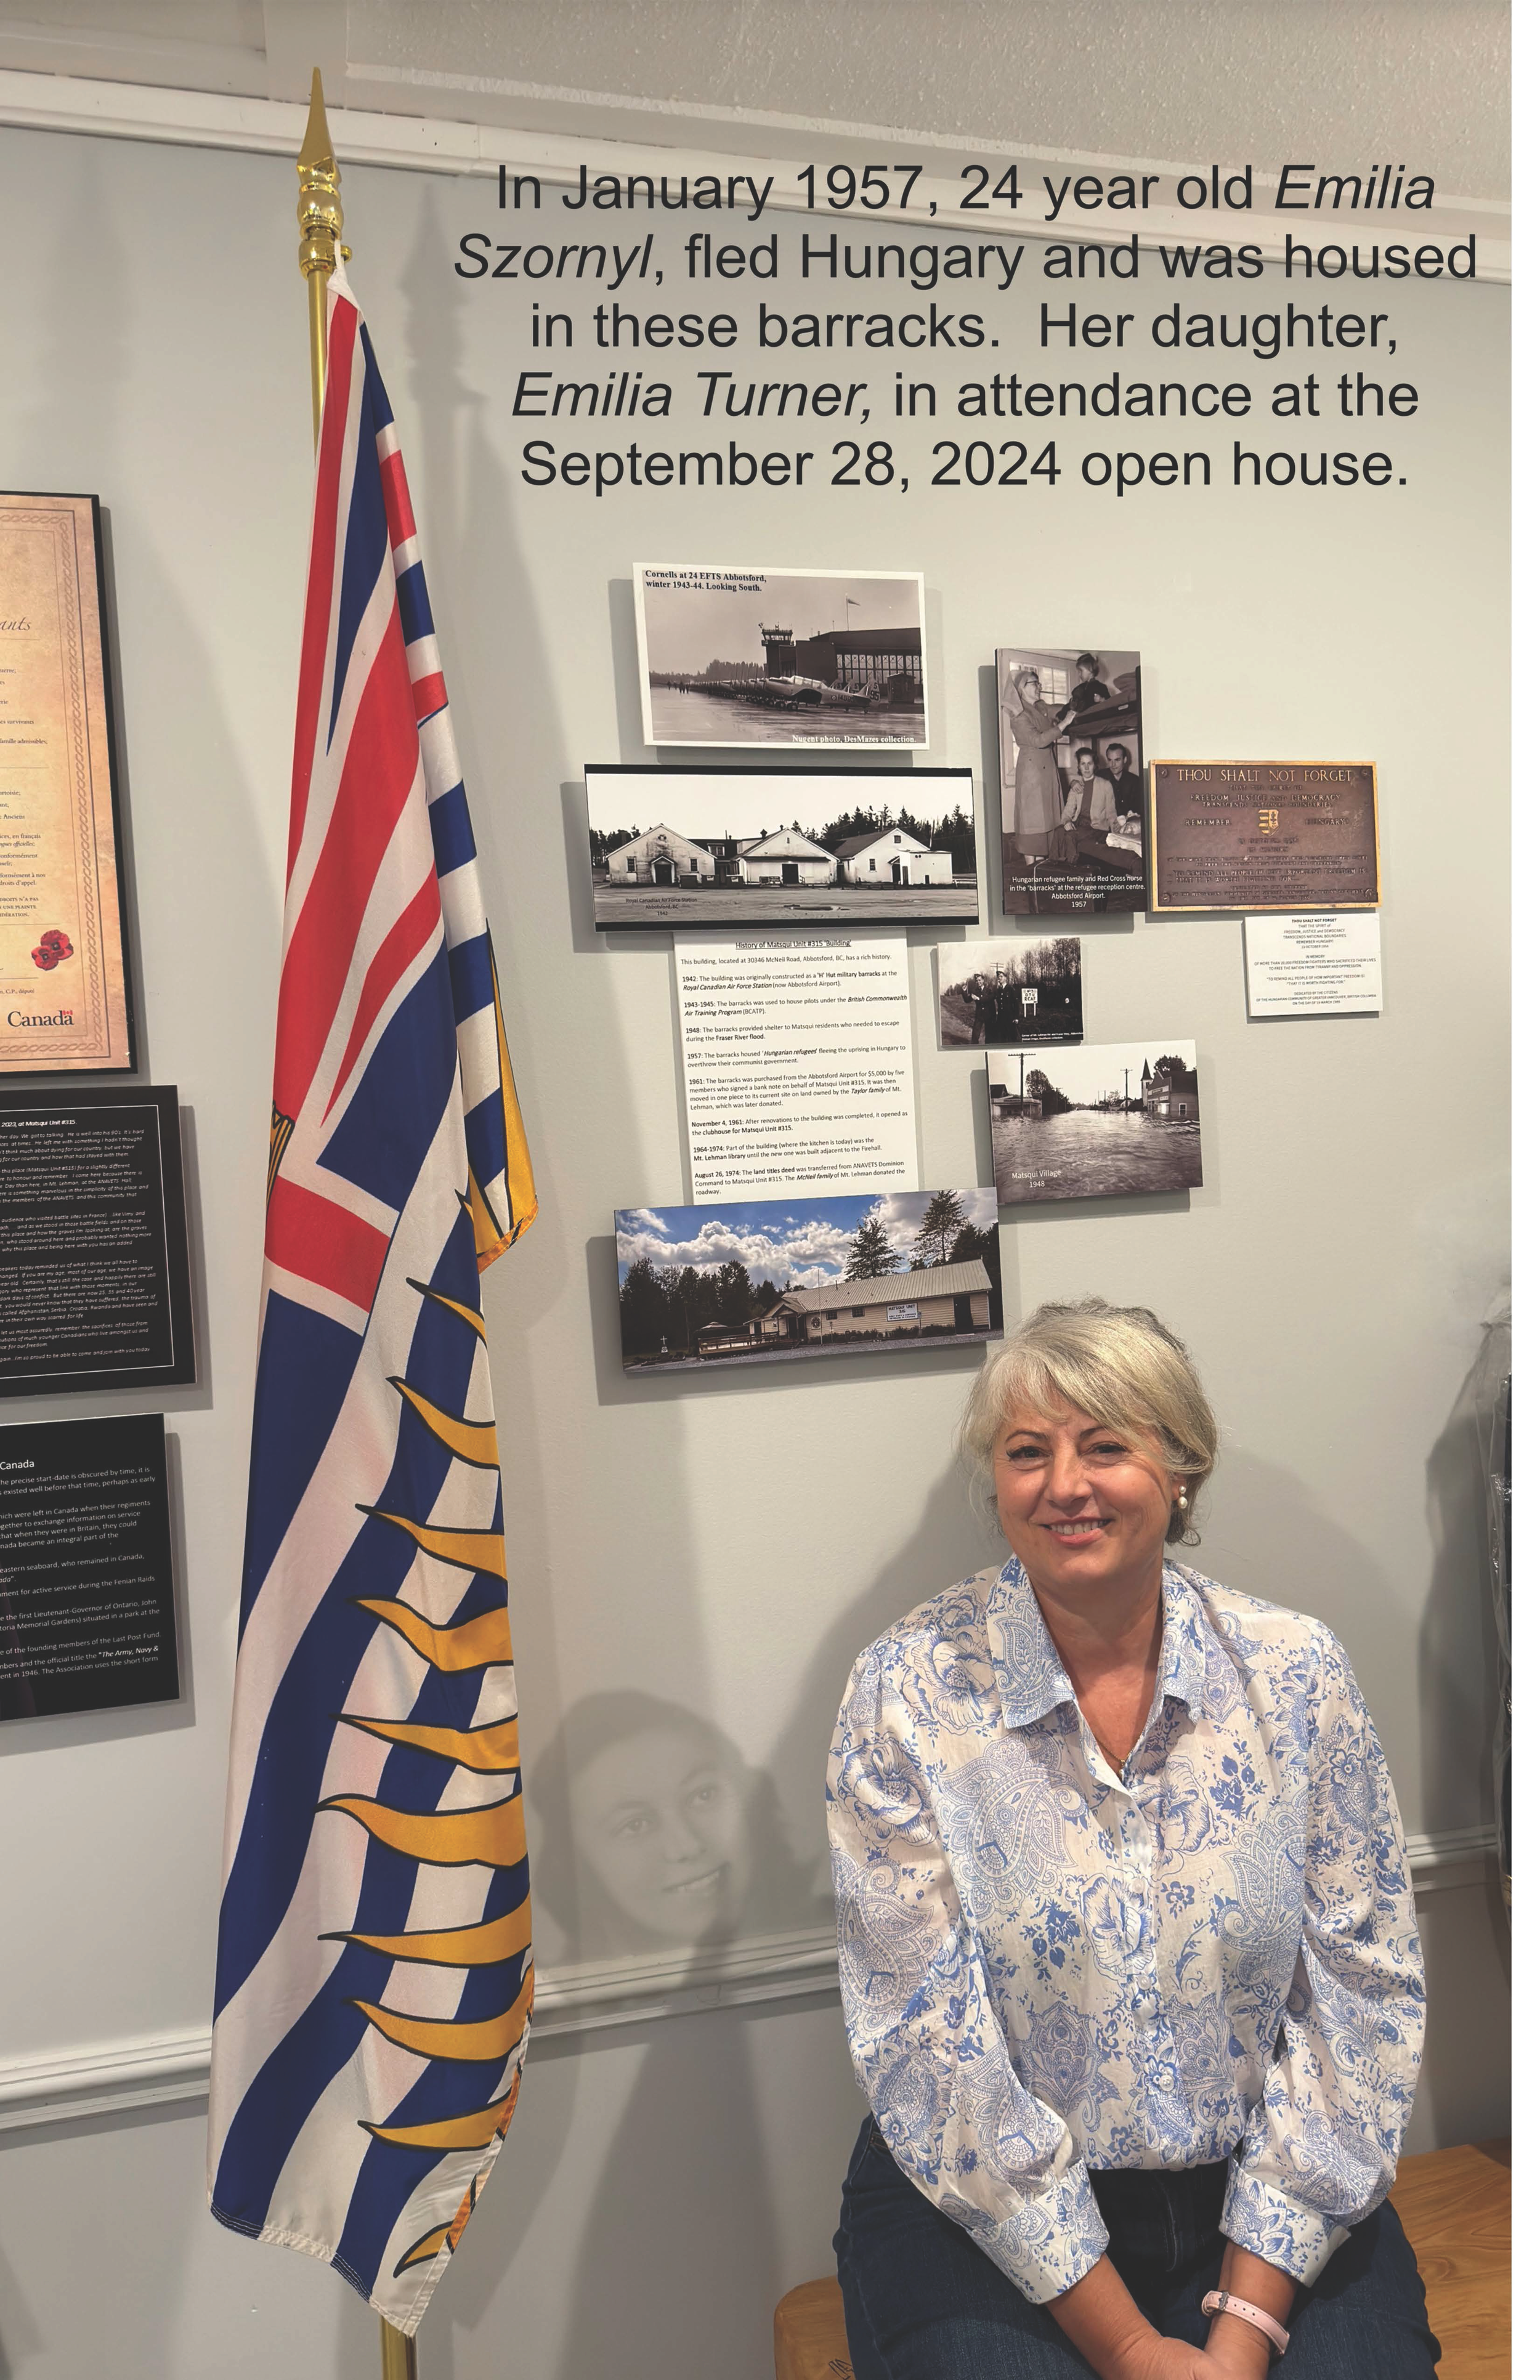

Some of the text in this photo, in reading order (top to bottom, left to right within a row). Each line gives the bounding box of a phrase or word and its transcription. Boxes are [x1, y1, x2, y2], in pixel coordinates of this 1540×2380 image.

[645, 570, 678, 578] Cornells
[700, 572, 721, 580] EFTS
[723, 573, 767, 583] Abbotsford,
[673, 581, 704, 589] 1943-44.
[706, 582, 737, 593] Looking
[792, 735, 819, 743] Nugent
[820, 736, 842, 744] photo,
[1177, 769, 1352, 782] THOU SHALT NOT FORGET
[1044, 876, 1066, 884] refugee
[7, 1010, 75, 1027] Canada
[1012, 1170, 1062, 1179] Matsqui Village
[1029, 1180, 1045, 1188] 1948
[0, 1459, 34, 1470] Canada
[78, 1470, 108, 1478] obscured
